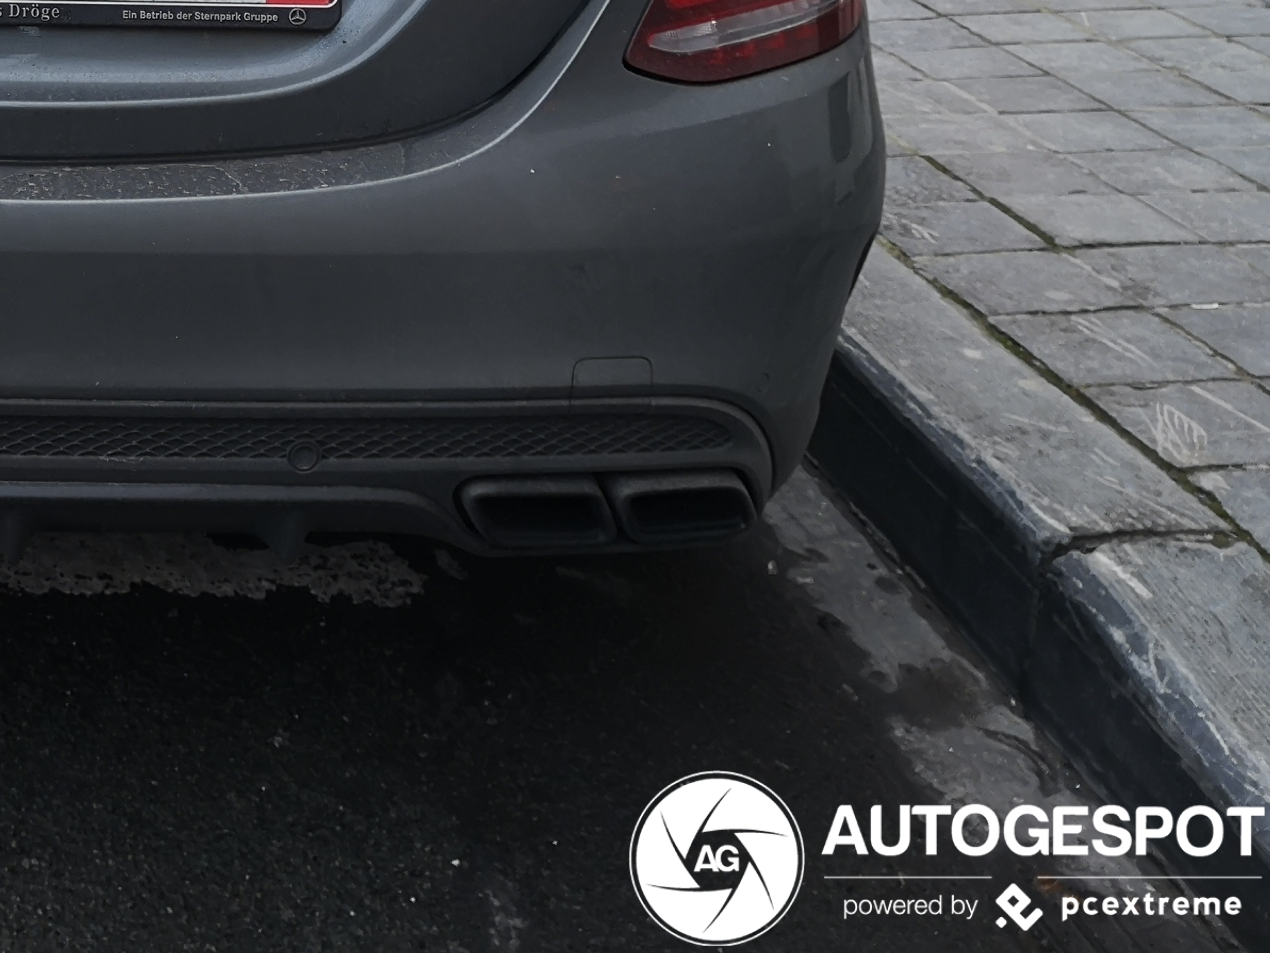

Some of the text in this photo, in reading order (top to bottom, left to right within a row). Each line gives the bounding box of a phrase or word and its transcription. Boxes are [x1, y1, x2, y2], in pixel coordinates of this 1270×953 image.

[8, 3, 61, 21] Dröge
[122, 9, 279, 24] Ein Betrieb der Sternpark Gruppe
